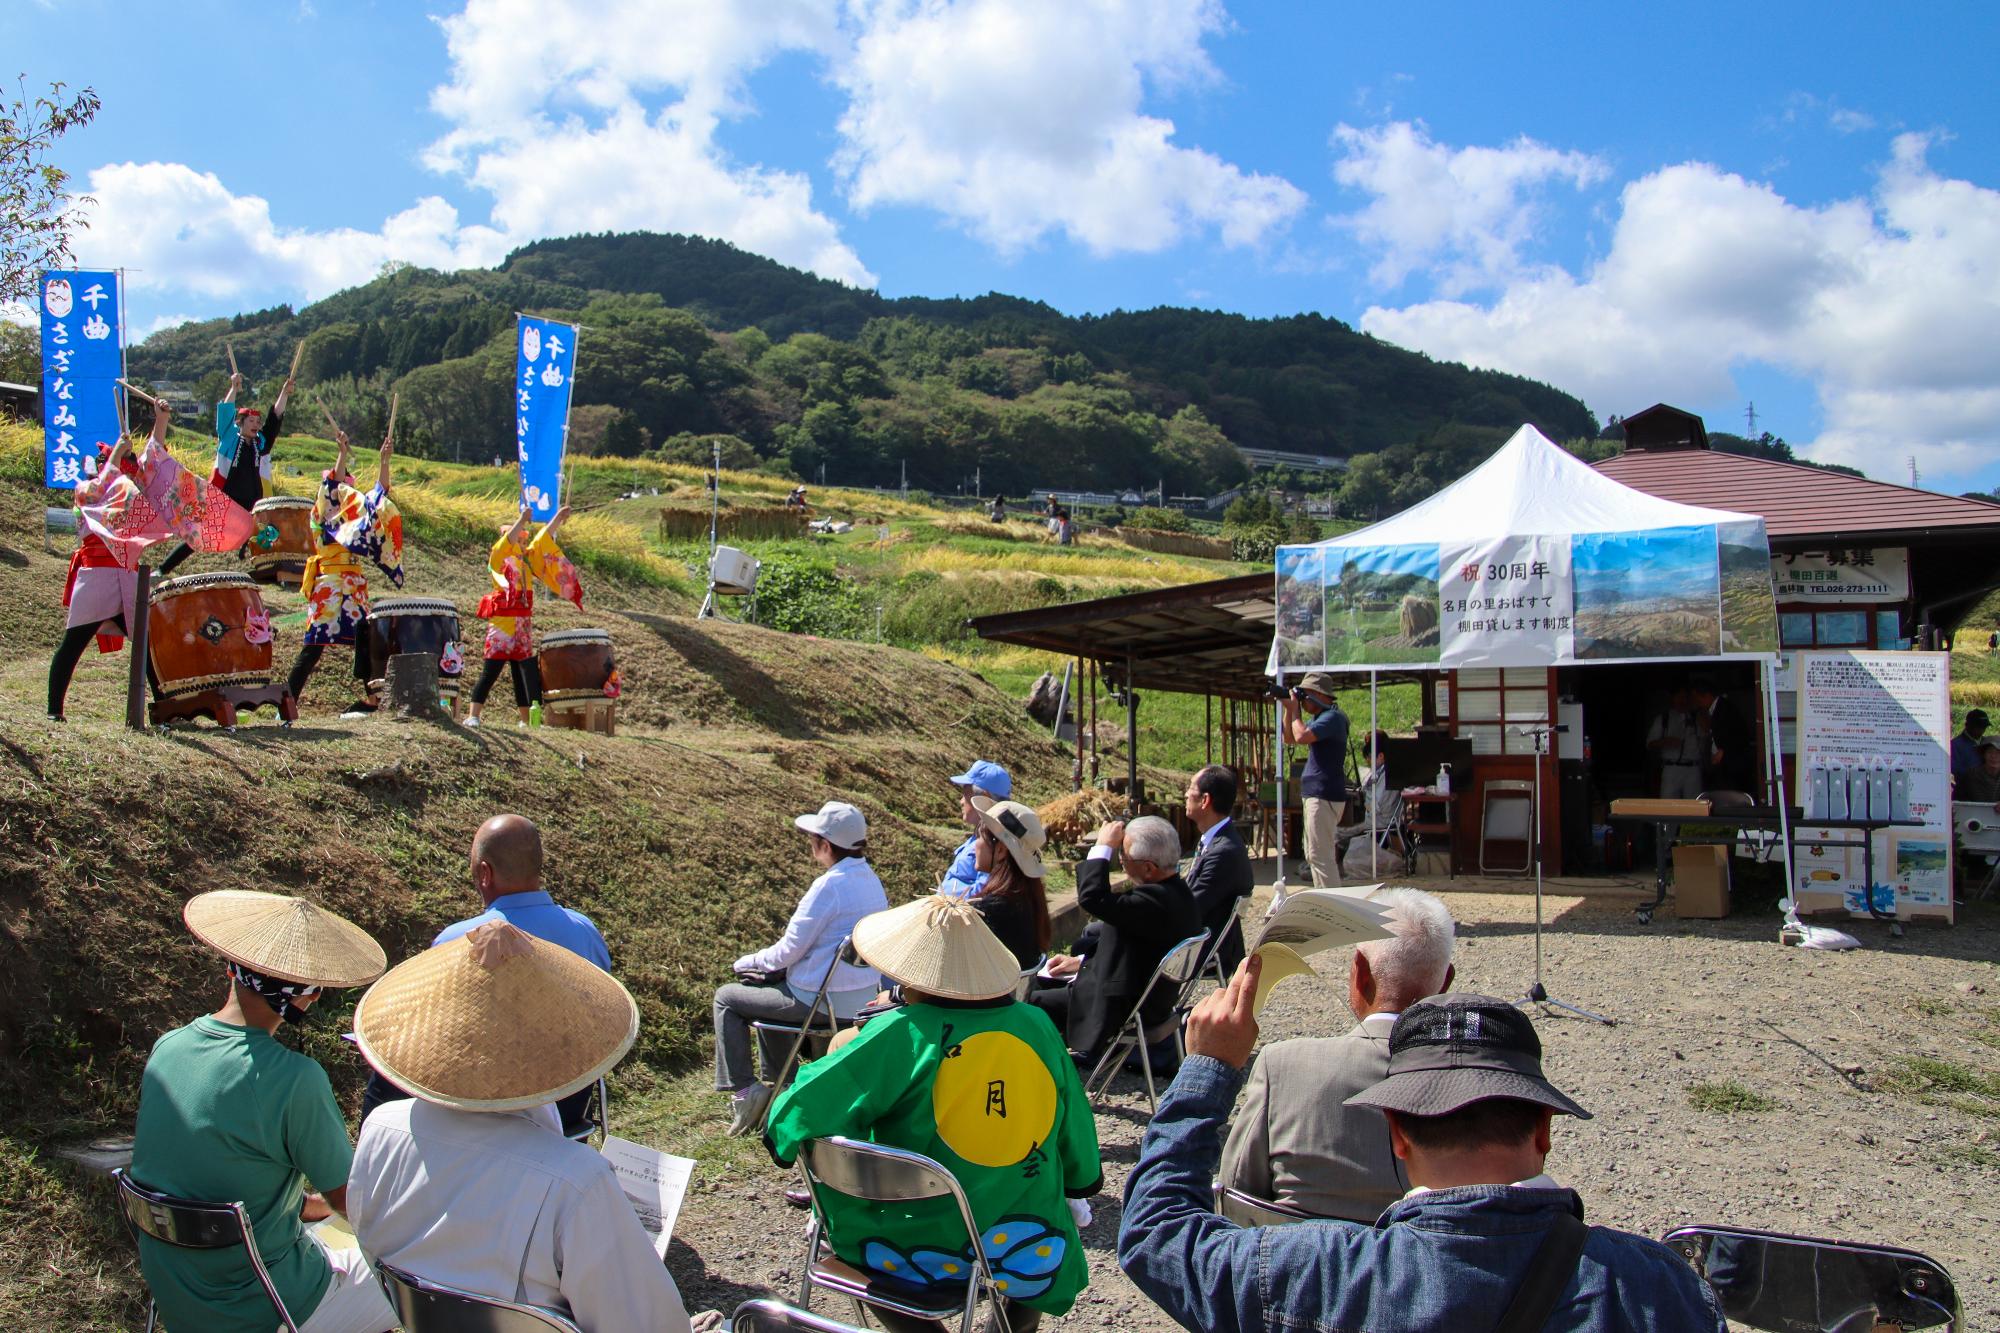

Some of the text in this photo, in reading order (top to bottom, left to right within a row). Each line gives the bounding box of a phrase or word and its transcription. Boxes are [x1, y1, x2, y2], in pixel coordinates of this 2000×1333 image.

[82, 283, 111, 341] 千曲
[51, 322, 82, 484] さざなみ太鼓
[1461, 560, 1550, 582] 祝 30周年
[1443, 596, 1552, 613] 名月の里おばすて
[1458, 615, 1571, 633] 棚田貸します制度
[986, 1080, 1006, 1118] 月
